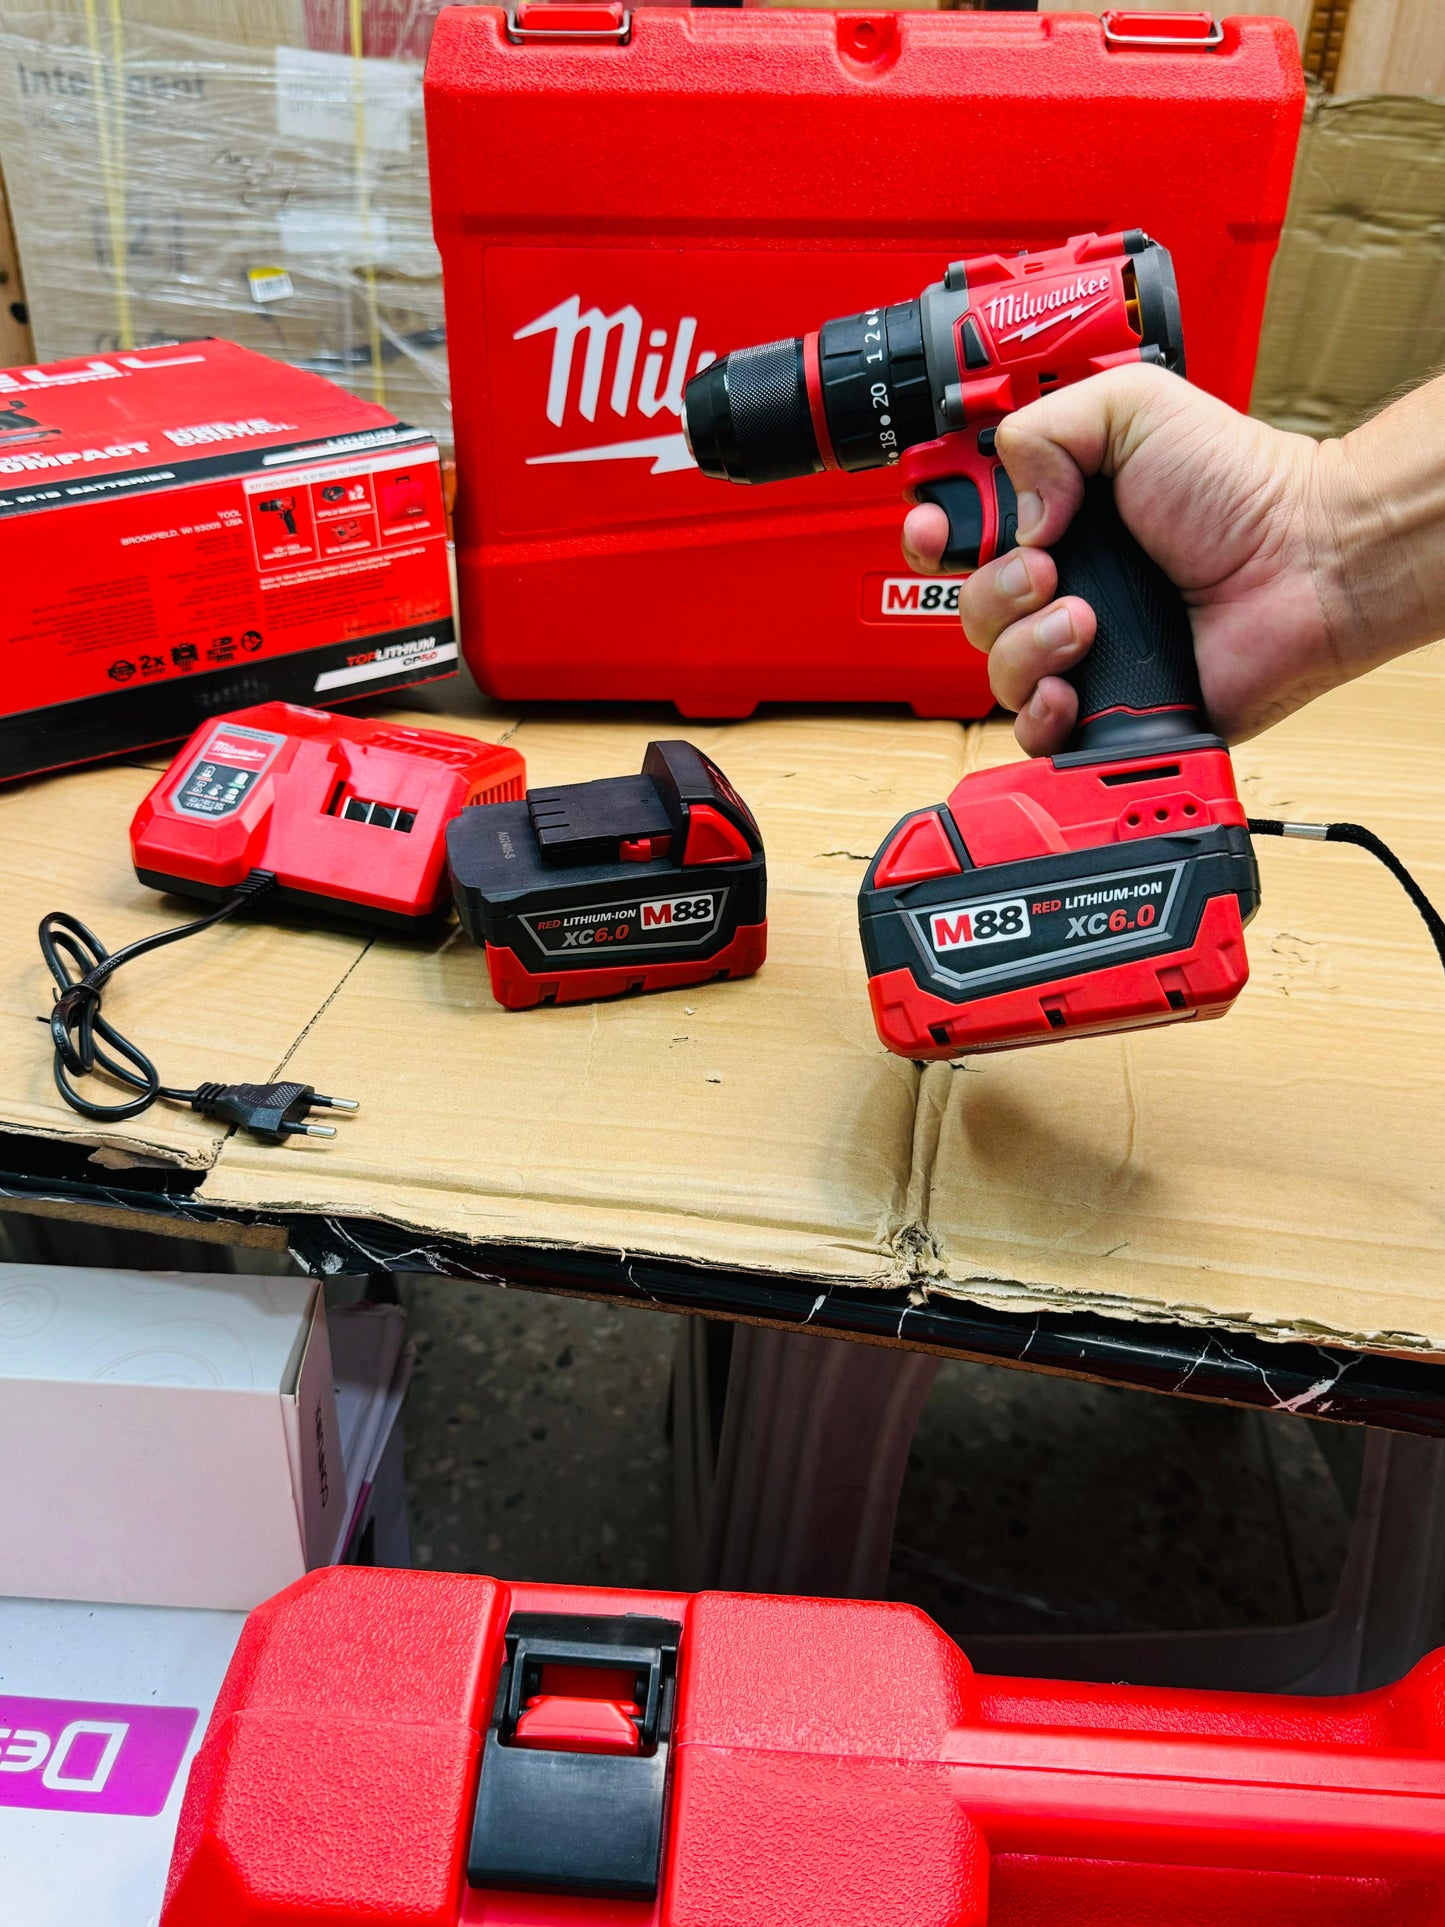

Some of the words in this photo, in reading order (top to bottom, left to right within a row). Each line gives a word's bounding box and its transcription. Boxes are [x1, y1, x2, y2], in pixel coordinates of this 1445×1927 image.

[985, 275, 1109, 330] Milwaukee
[513, 294, 716, 427] Mil
[870, 382, 890, 409] 20
[217, 509, 242, 520] TOOL
[886, 585, 962, 610] M88
[139, 655, 165, 670] 2x
[643, 898, 712, 926] M88
[1032, 899, 1062, 915] RED
[1065, 881, 1163, 910] LITHIUM-ION
[537, 920, 561, 930] RED
[563, 909, 637, 927] LITHIUM-ION
[934, 905, 1024, 947] M88
[1064, 904, 1156, 941] XC6.0
[561, 924, 630, 948] XC6.0
[0, 1719, 130, 1793] De
